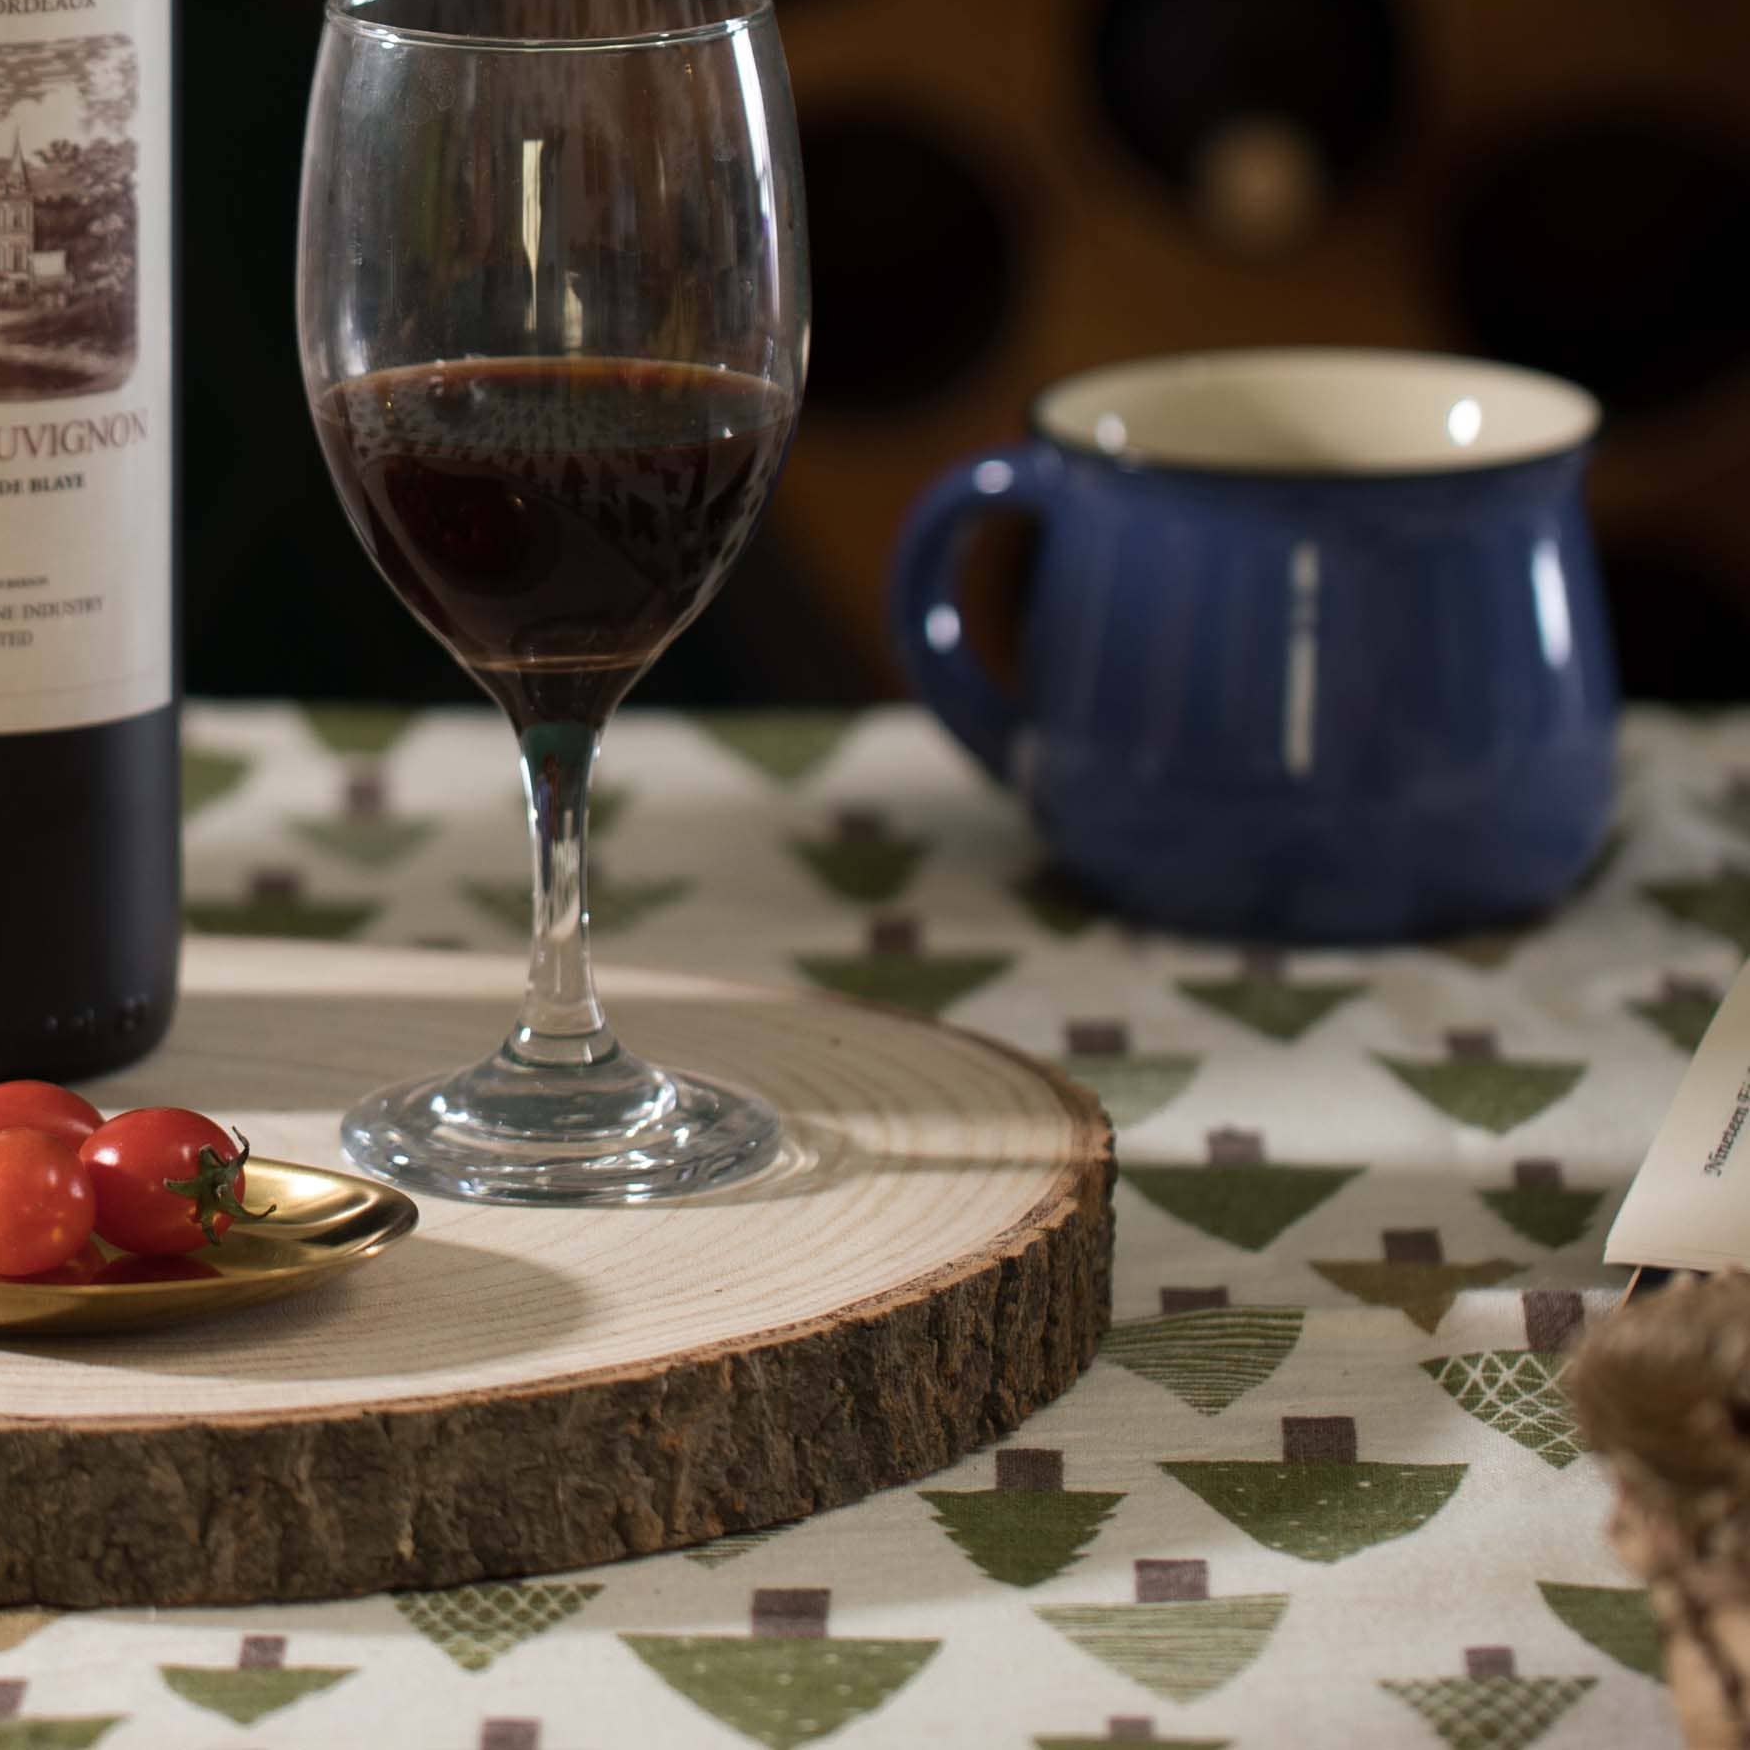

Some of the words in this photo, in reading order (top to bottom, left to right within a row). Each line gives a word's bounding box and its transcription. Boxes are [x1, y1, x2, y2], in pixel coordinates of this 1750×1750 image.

[30, 474, 86, 493] BLAYE
[22, 596, 103, 619] INDUSTRY
[1704, 1106, 1749, 1176] Nineteen
